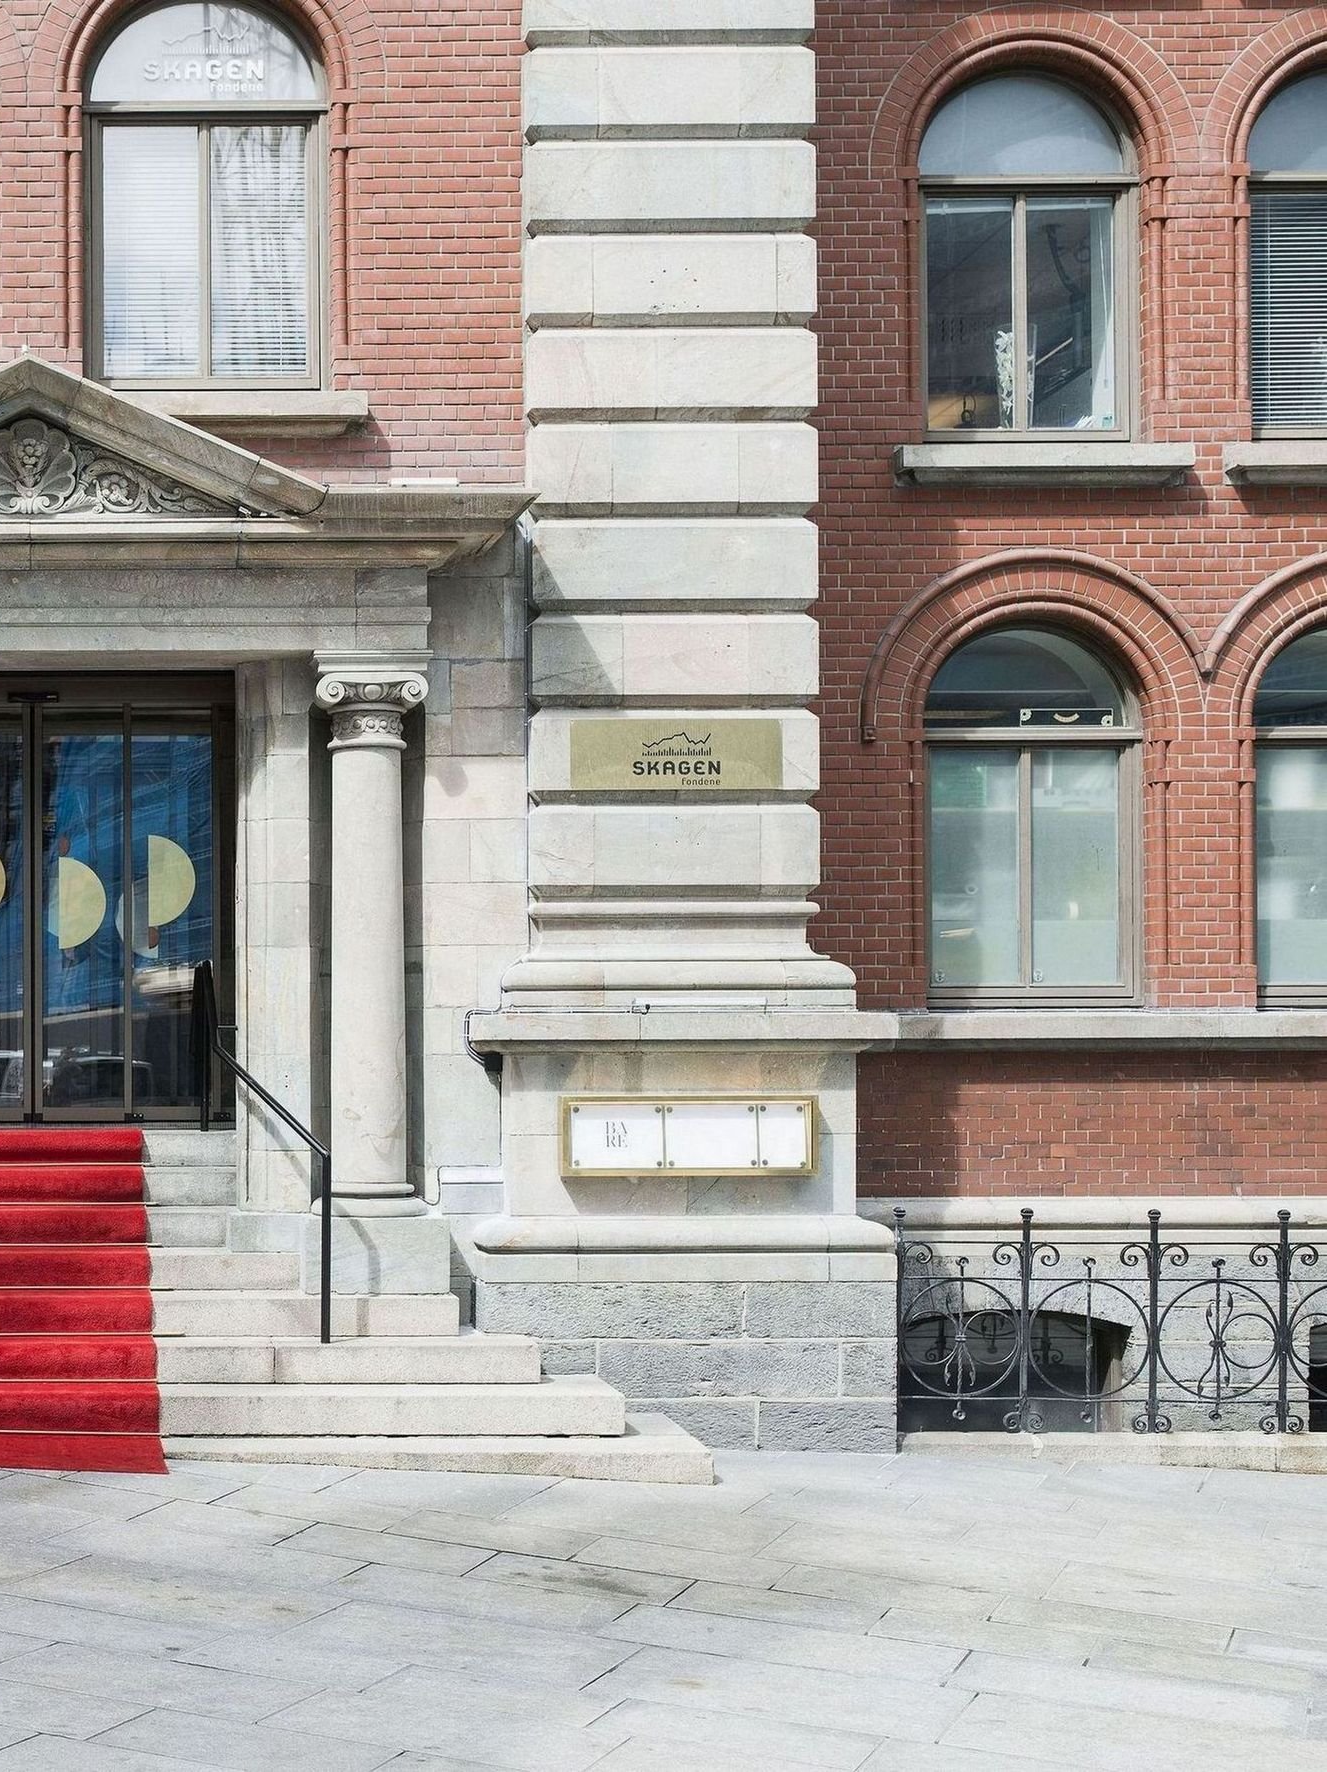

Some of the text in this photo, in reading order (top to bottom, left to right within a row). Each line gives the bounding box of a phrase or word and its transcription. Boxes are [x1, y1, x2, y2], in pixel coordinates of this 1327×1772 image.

[143, 59, 265, 82] SKAGEN
[632, 760, 721, 776] SKAGEN
[681, 778, 721, 786] fondene
